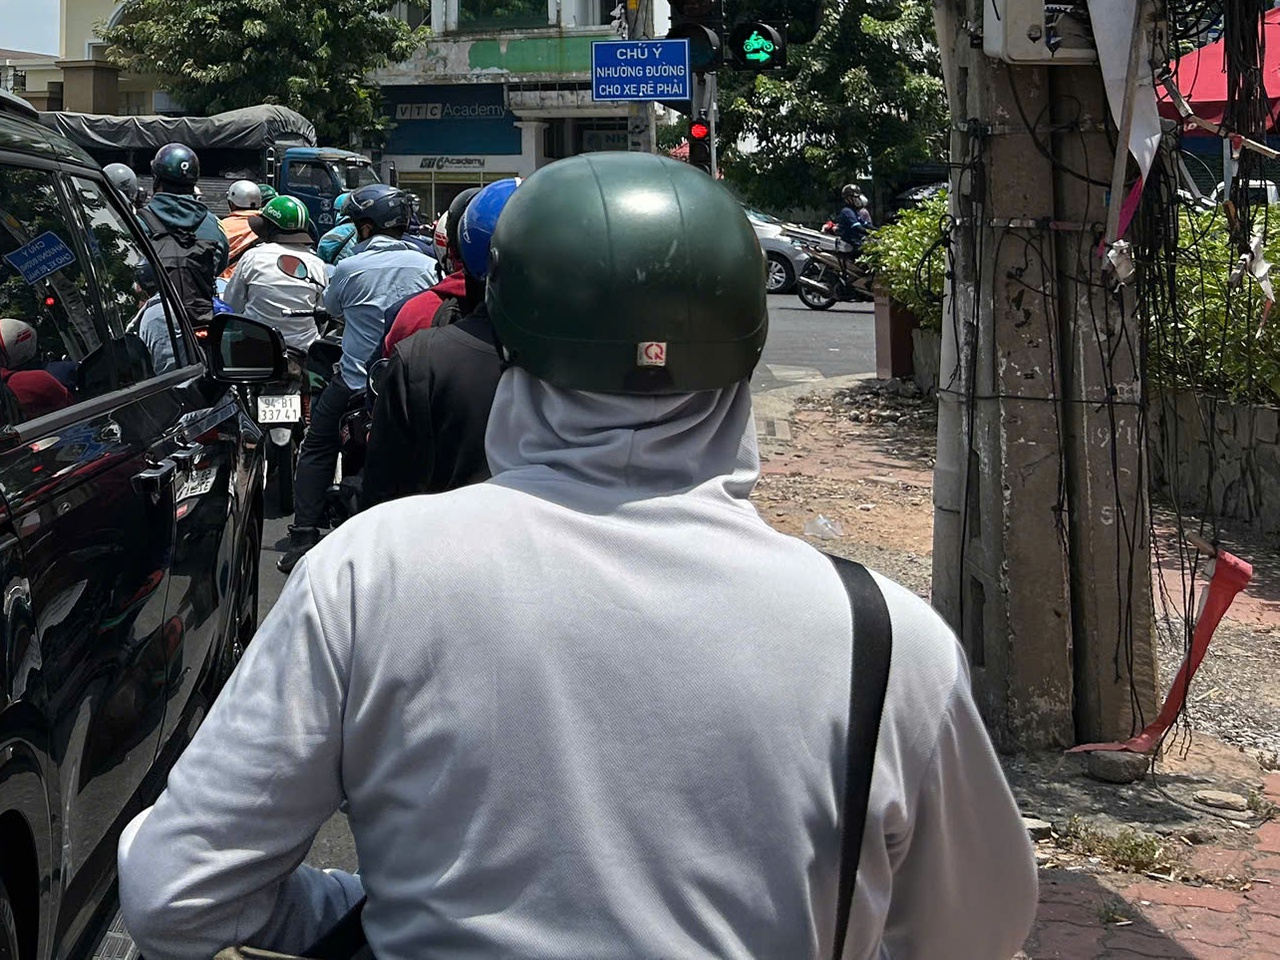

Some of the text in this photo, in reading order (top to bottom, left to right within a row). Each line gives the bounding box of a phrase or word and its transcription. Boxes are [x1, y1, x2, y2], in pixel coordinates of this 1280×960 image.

[652, 43, 663, 58] Ý
[596, 61, 685, 77] NHƯỜNG ĐƯỜNG
[599, 79, 683, 96] CHO XE RẼ PHẢI
[396, 103, 507, 120] VTC Academy
[444, 157, 485, 168] Academy
[268, 206, 282, 219] Grab
